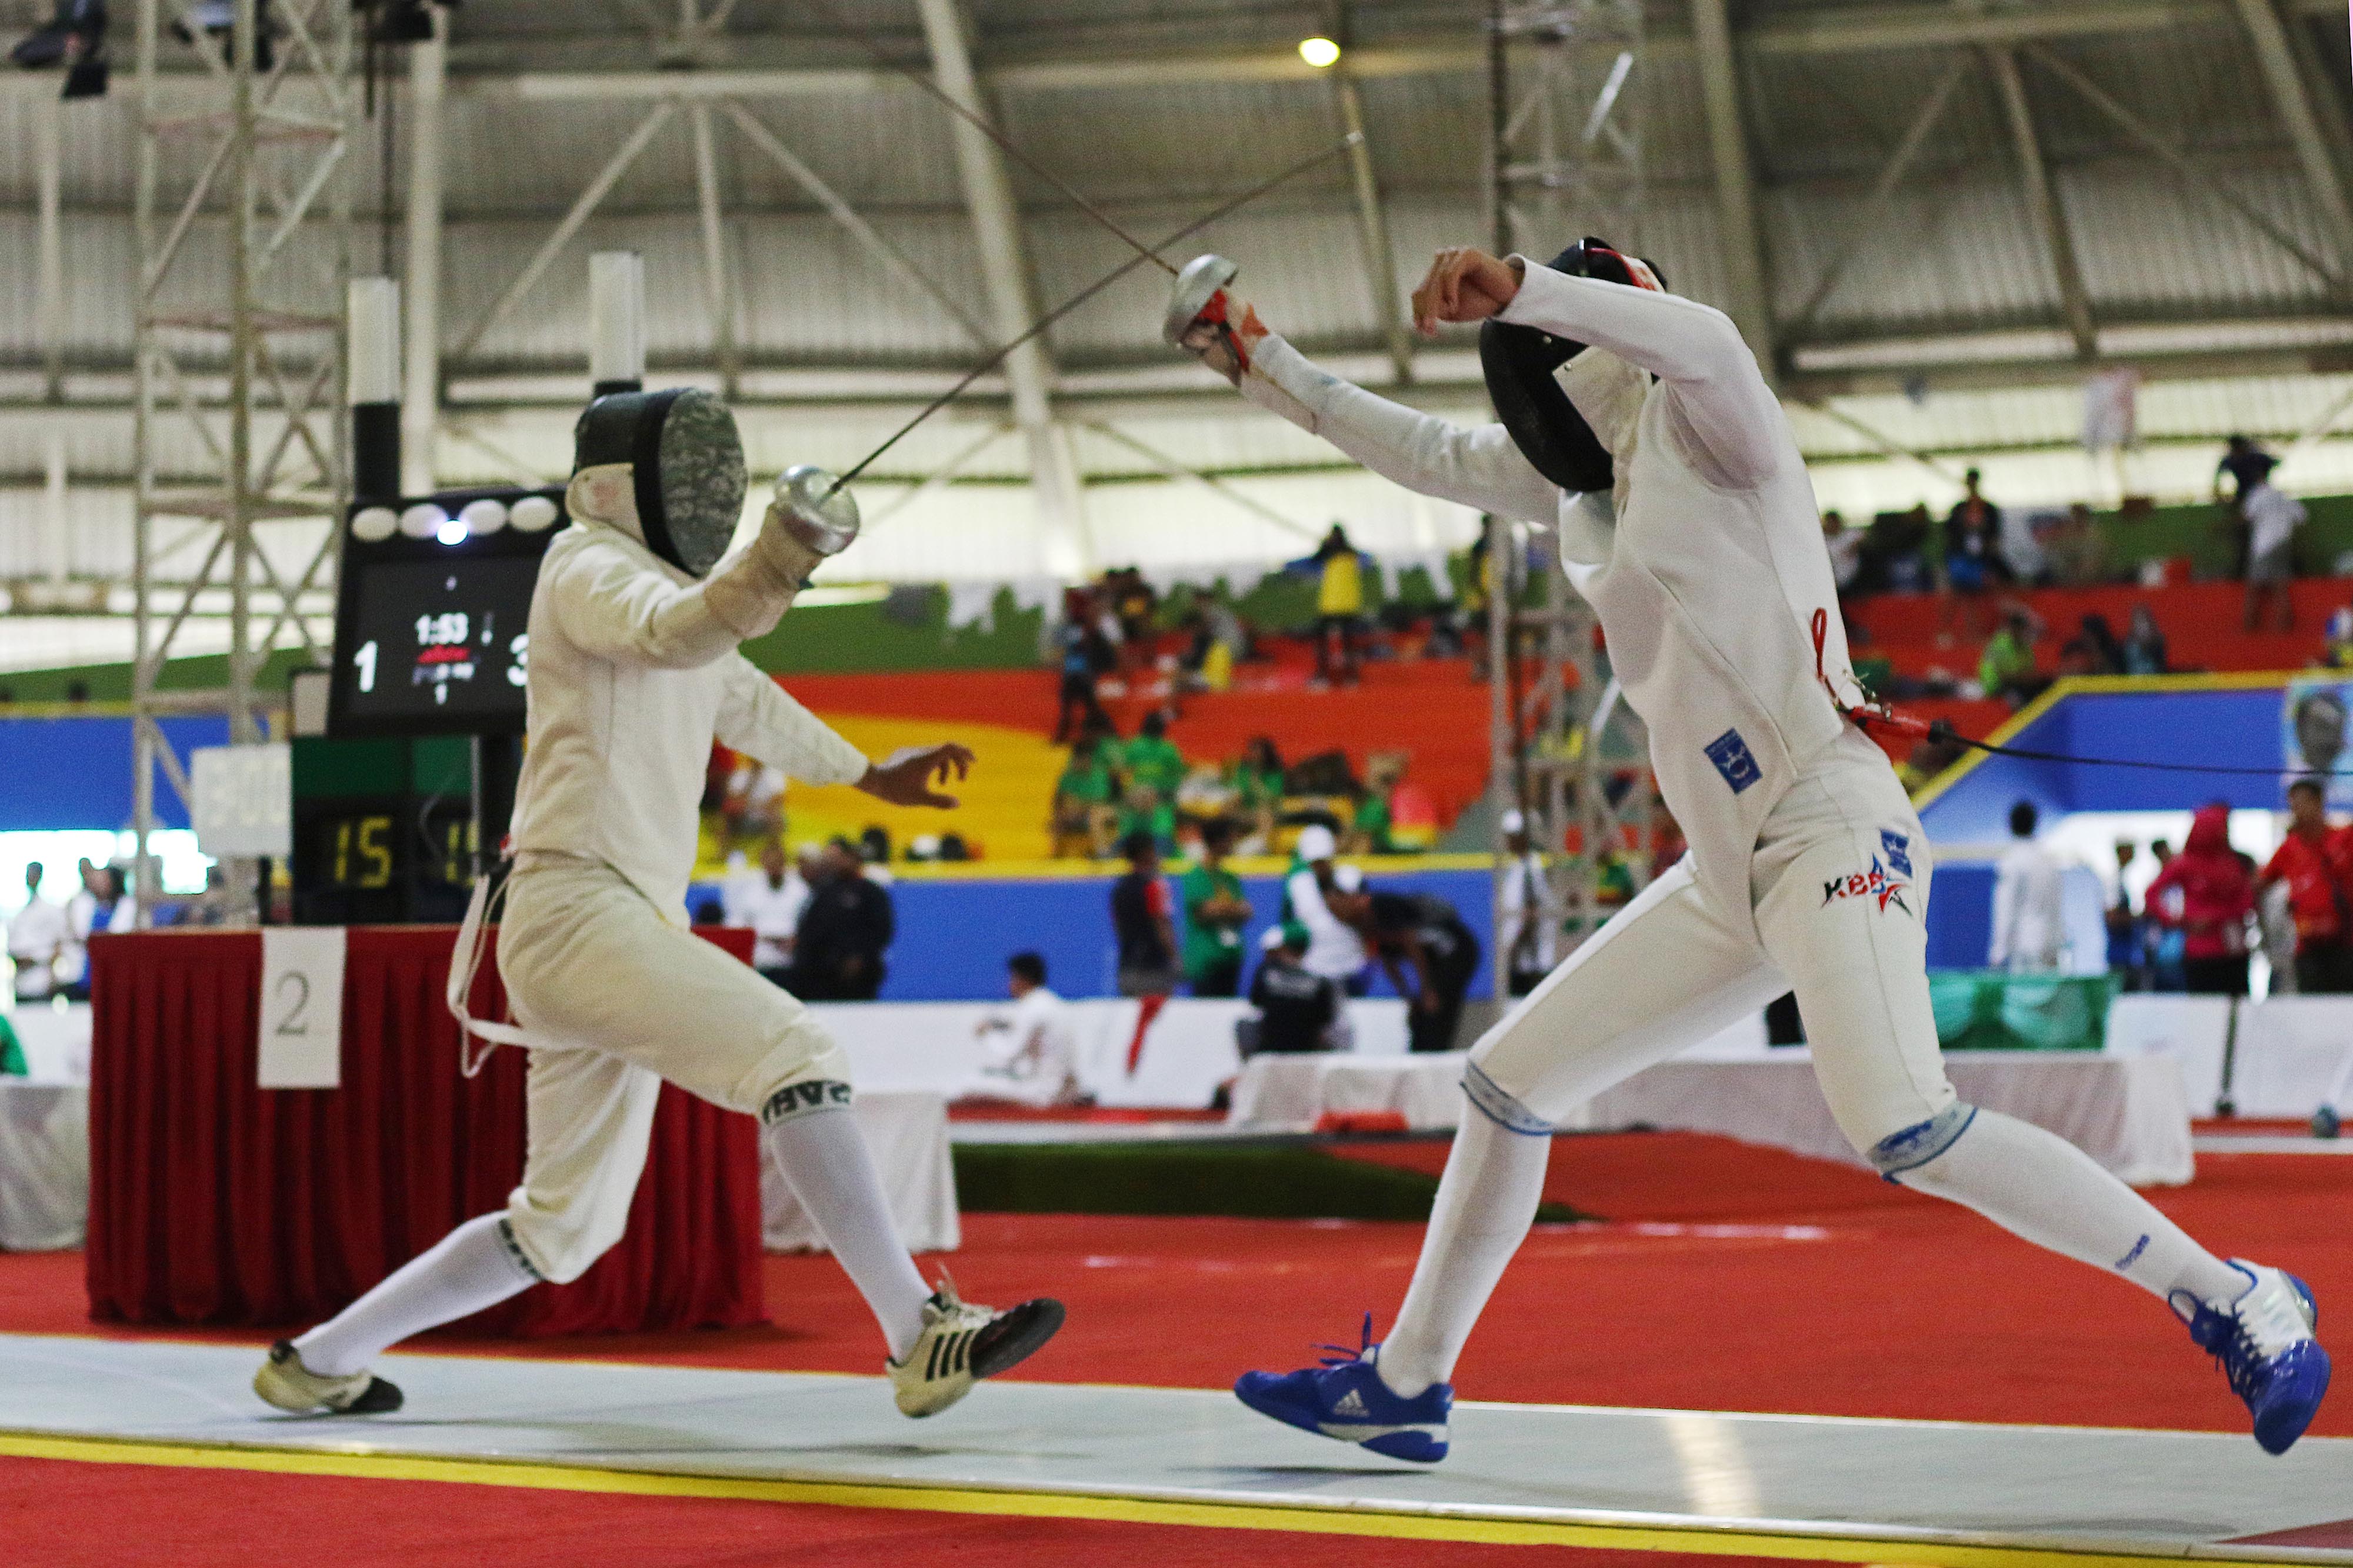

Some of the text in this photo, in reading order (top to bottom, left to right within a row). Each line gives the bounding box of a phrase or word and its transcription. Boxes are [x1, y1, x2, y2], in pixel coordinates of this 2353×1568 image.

[354, 640, 378, 692] 1
[334, 817, 392, 888] 15
[274, 971, 310, 1036] 2
